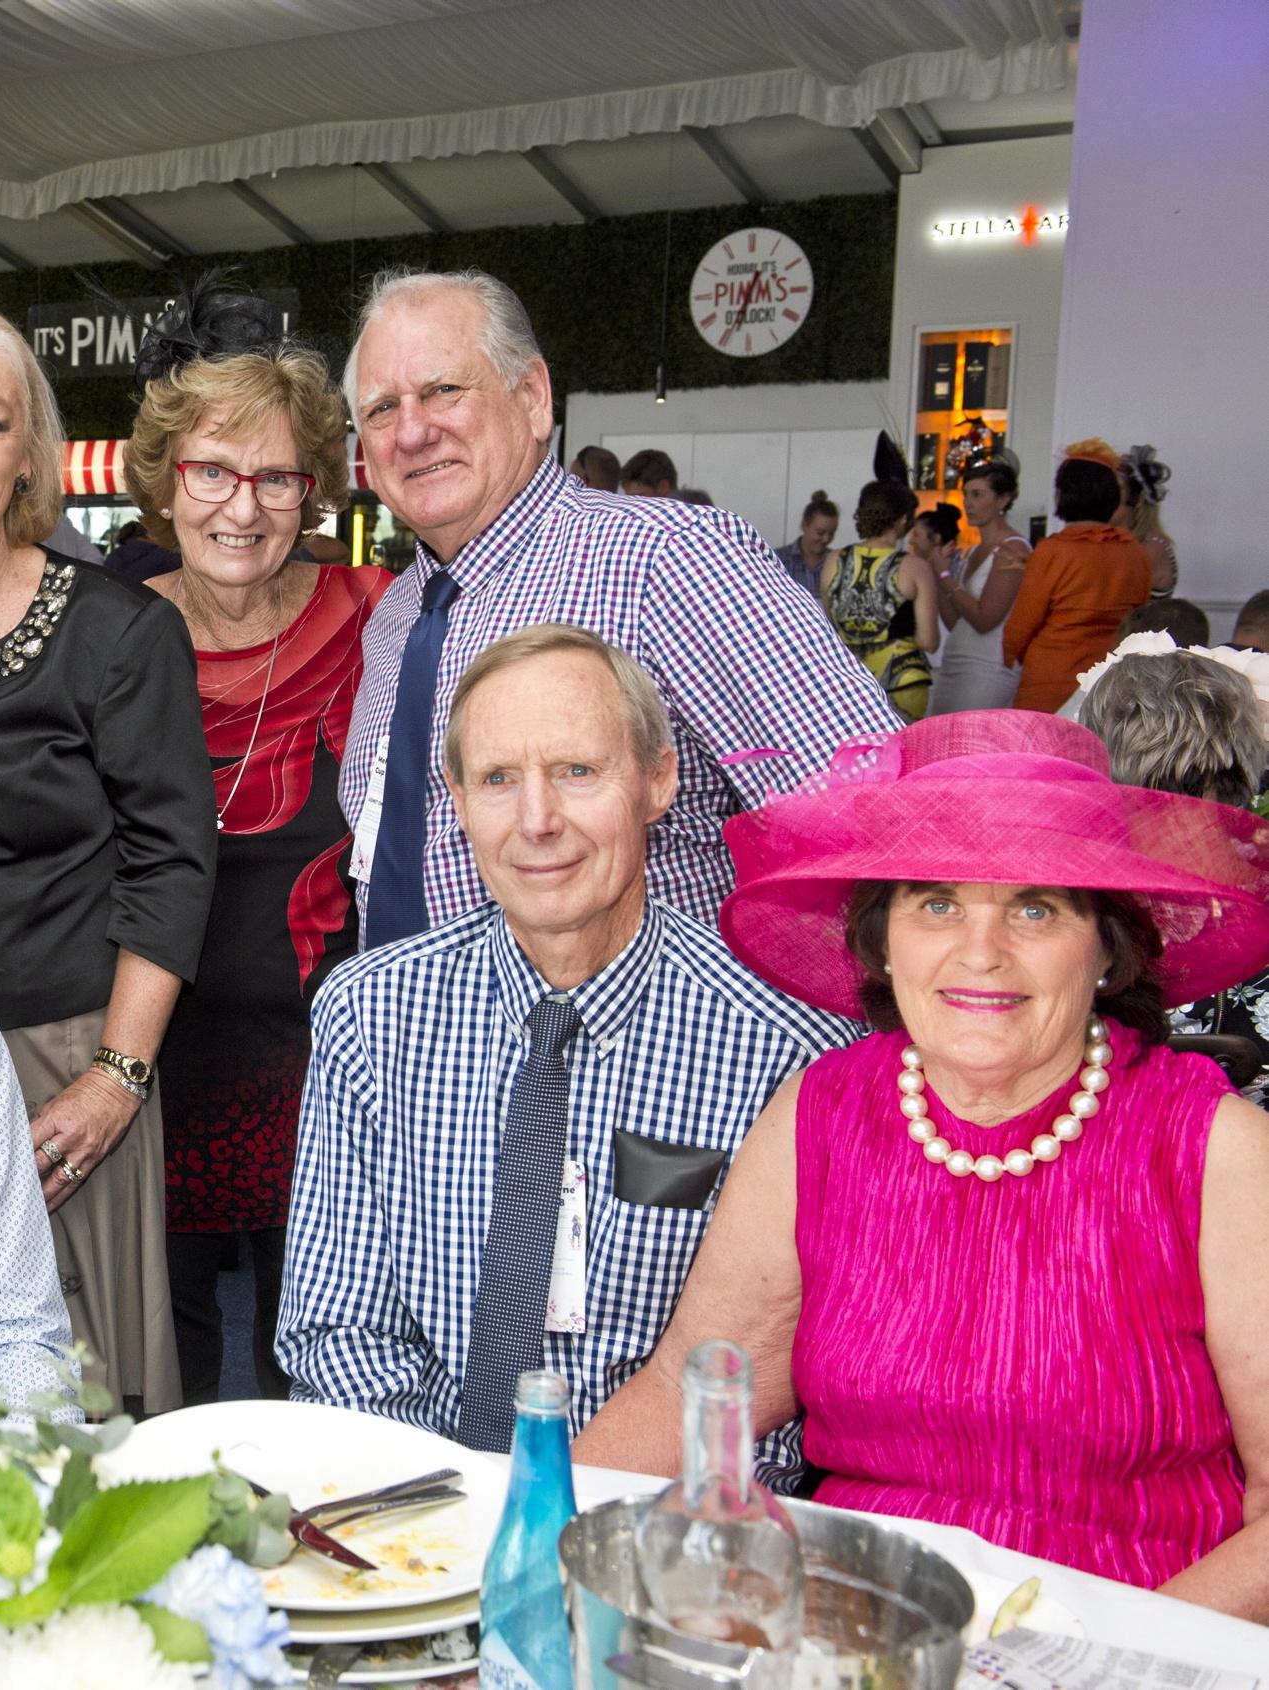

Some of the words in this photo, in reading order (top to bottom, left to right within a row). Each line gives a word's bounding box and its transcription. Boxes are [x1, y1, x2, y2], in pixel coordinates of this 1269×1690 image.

[933, 219, 1015, 236] STELLA
[714, 272, 788, 307] PIMM'S
[33, 326, 66, 356] IT'S
[375, 766, 385, 776] Cup
